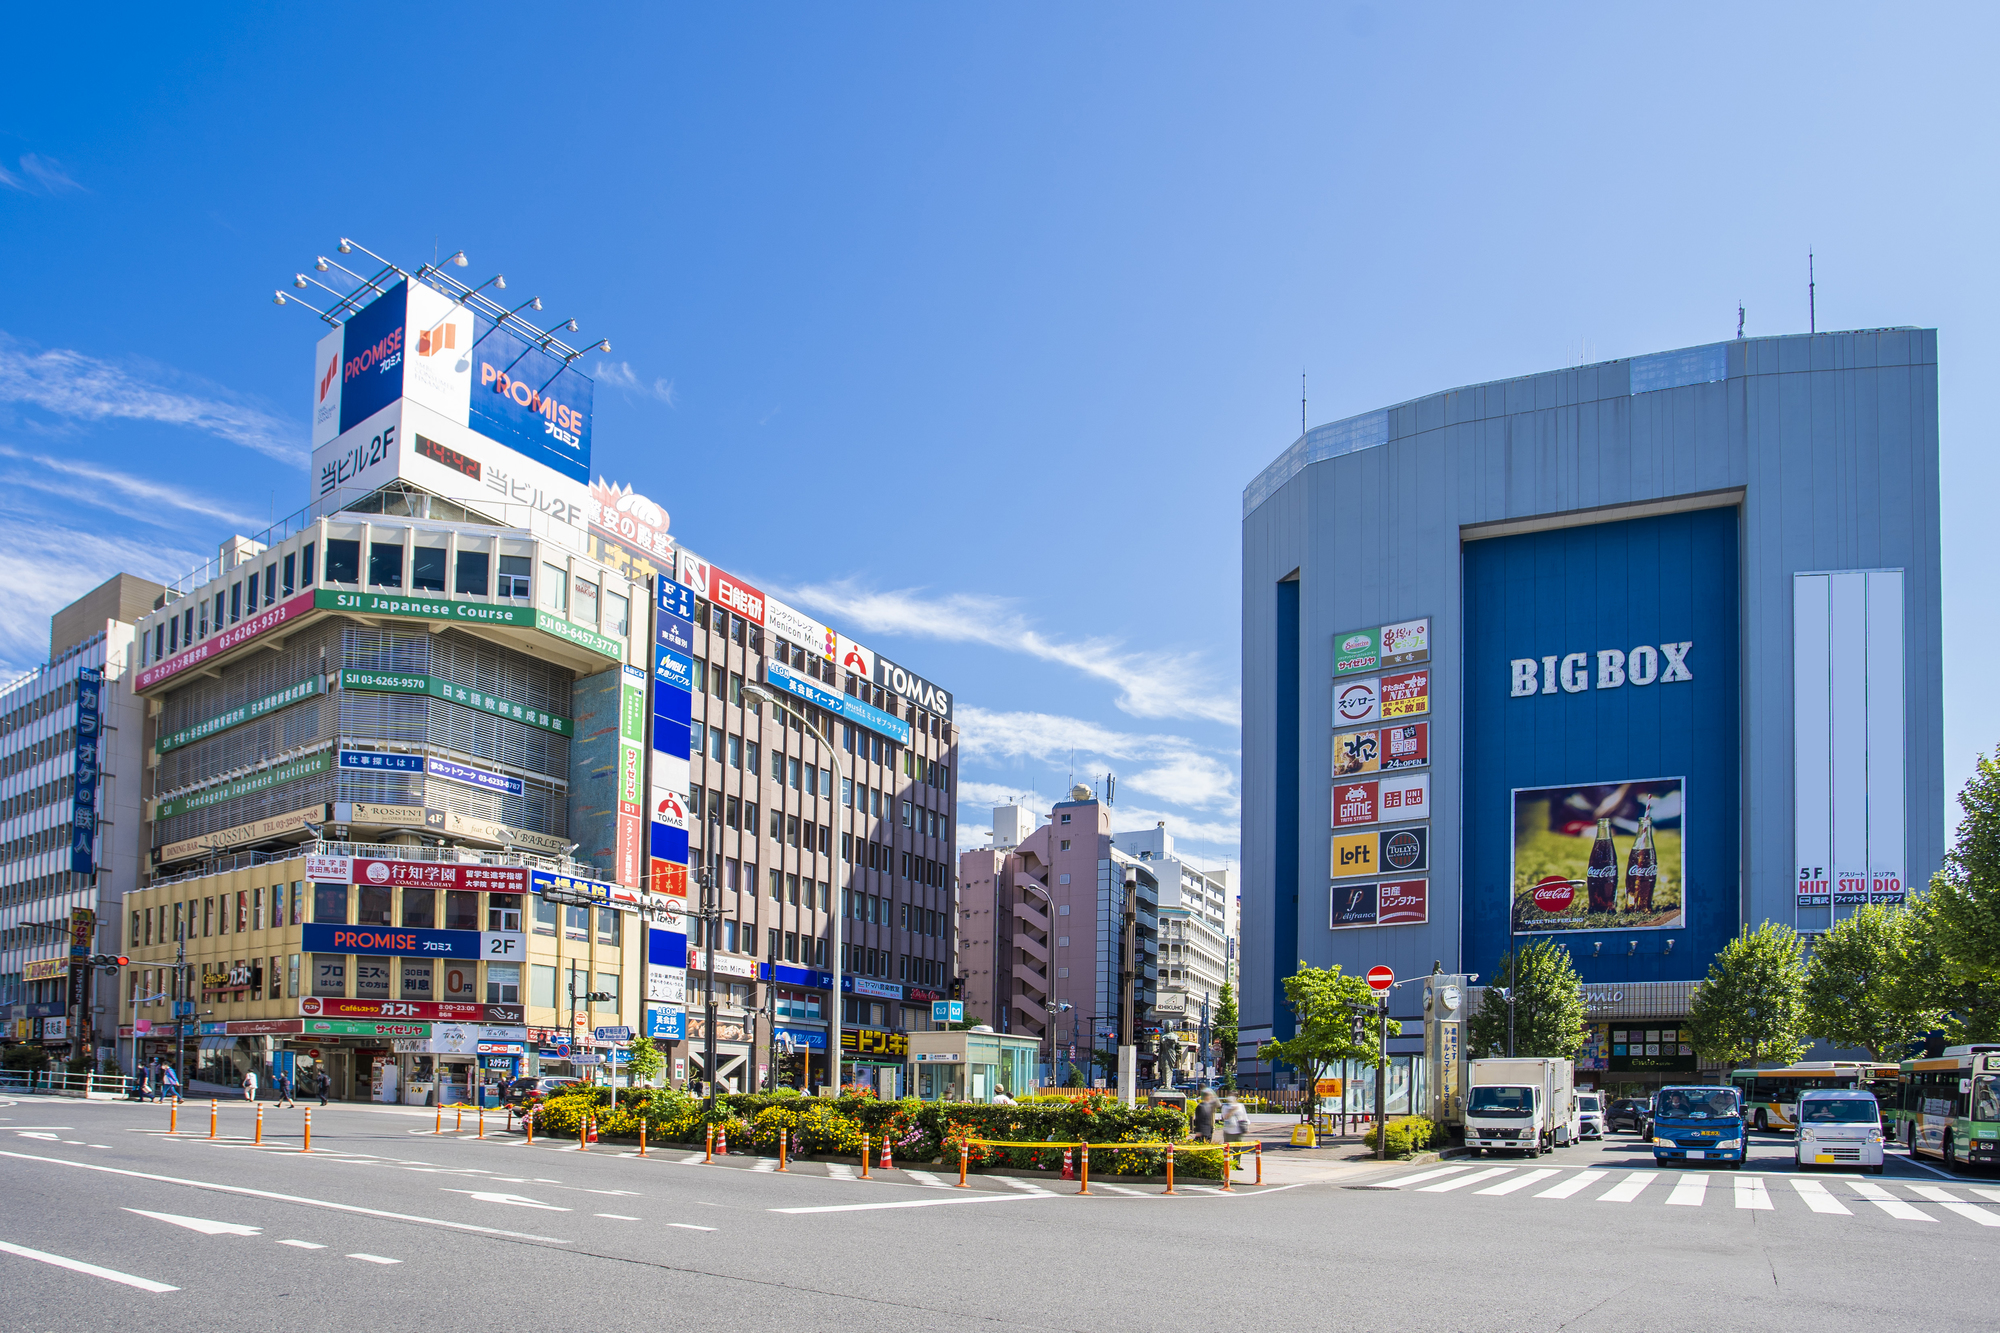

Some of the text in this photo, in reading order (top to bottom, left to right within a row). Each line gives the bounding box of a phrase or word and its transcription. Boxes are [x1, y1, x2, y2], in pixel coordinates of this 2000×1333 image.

[344, 326, 403, 383] PROMISE
[379, 352, 402, 374] プロミス
[481, 362, 583, 436] PROMISE
[544, 422, 581, 450] プロミス
[320, 425, 396, 496] 当ビル2F
[425, 439, 478, 479] 14:42
[486, 465, 582, 525] 当ビル2F
[337, 594, 514, 621] SJI Japanese Course
[719, 578, 763, 621] 日能研
[770, 605, 814, 634] コンタクトレンズ
[539, 614, 555, 630] SJI
[554, 621, 619, 656] 03-6457-3778
[661, 630, 688, 649] 東京個別
[769, 614, 824, 651] Menicon Miru
[154, 646, 208, 680] スタントン英語学院
[219, 607, 286, 649] 03-6265-9573
[770, 663, 790, 679] AEON
[1337, 656, 1377, 671] サイゼリヤ
[1510, 641, 1693, 698] BIG BOX
[81, 671, 99, 683] B1F
[346, 673, 425, 690] SJI 03-6265-9570
[656, 667, 691, 687] 東急リバブル
[788, 679, 843, 711] 英会話イーオン
[879, 659, 948, 716] TOMAS
[1389, 687, 1421, 701] NEXT
[442, 684, 563, 731] 日本語教師養成講座
[1337, 696, 1376, 710] スシロー
[1382, 701, 1426, 717] 食べ放題
[163, 737, 171, 749] SJI
[251, 681, 313, 716] 日本語教師養成講座
[866, 712, 908, 736] ミュゼプラチナム
[1344, 734, 1378, 762] わん
[1403, 758, 1422, 767] OPEN
[74, 688, 97, 855] カラオケの鉄人
[430, 761, 521, 792] 夢ネットワーク 03-6233-8787
[626, 749, 636, 800] サイゼリヤ
[163, 759, 322, 816] SJI Sendagaya Japanese Institute
[1407, 790, 1420, 798] UNI
[624, 803, 635, 814] B1
[1406, 796, 1422, 805] QLO
[370, 807, 422, 817] ROSSINI
[1340, 801, 1372, 818] GAME
[428, 814, 444, 824] 4F
[657, 813, 683, 827] TOMAS
[1353, 814, 1372, 822] STATION
[166, 809, 318, 857] DINING BAR ROSSINI TEL 03-3209-5768
[485, 826, 518, 842] CON
[520, 832, 565, 851] BARLEY
[307, 858, 348, 868] 行知学園
[307, 865, 347, 875] 高田馬場校
[391, 864, 456, 882] 行知学園
[465, 869, 523, 881] 留学生進学指導
[1799, 867, 1823, 880] 5F
[465, 880, 488, 888] 大学院
[1381, 886, 1401, 897] 日産
[1798, 880, 1829, 894] HIIT
[1381, 896, 1424, 908] レンタカー
[1534, 887, 1573, 901] Coca-Cola
[334, 931, 453, 952] PROMISE プロミス
[490, 938, 516, 954] 2F
[229, 967, 251, 986] ガスト
[404, 968, 431, 977] 30日間
[730, 964, 746, 974] Miru
[404, 978, 430, 991] 利息
[864, 981, 900, 993] ヤマハ音楽教室
[339, 1002, 421, 1017] Caféレストラン ガスト
[506, 1011, 520, 1021] 2F
[656, 1007, 677, 1016] AEON
[656, 1015, 677, 1025] 英会話
[374, 1023, 424, 1036] サイゼリヤ
[653, 1024, 680, 1034] イーオン
[489, 1058, 511, 1068] スクラッチ
[1316, 1084, 1336, 1094] 閉鎖
